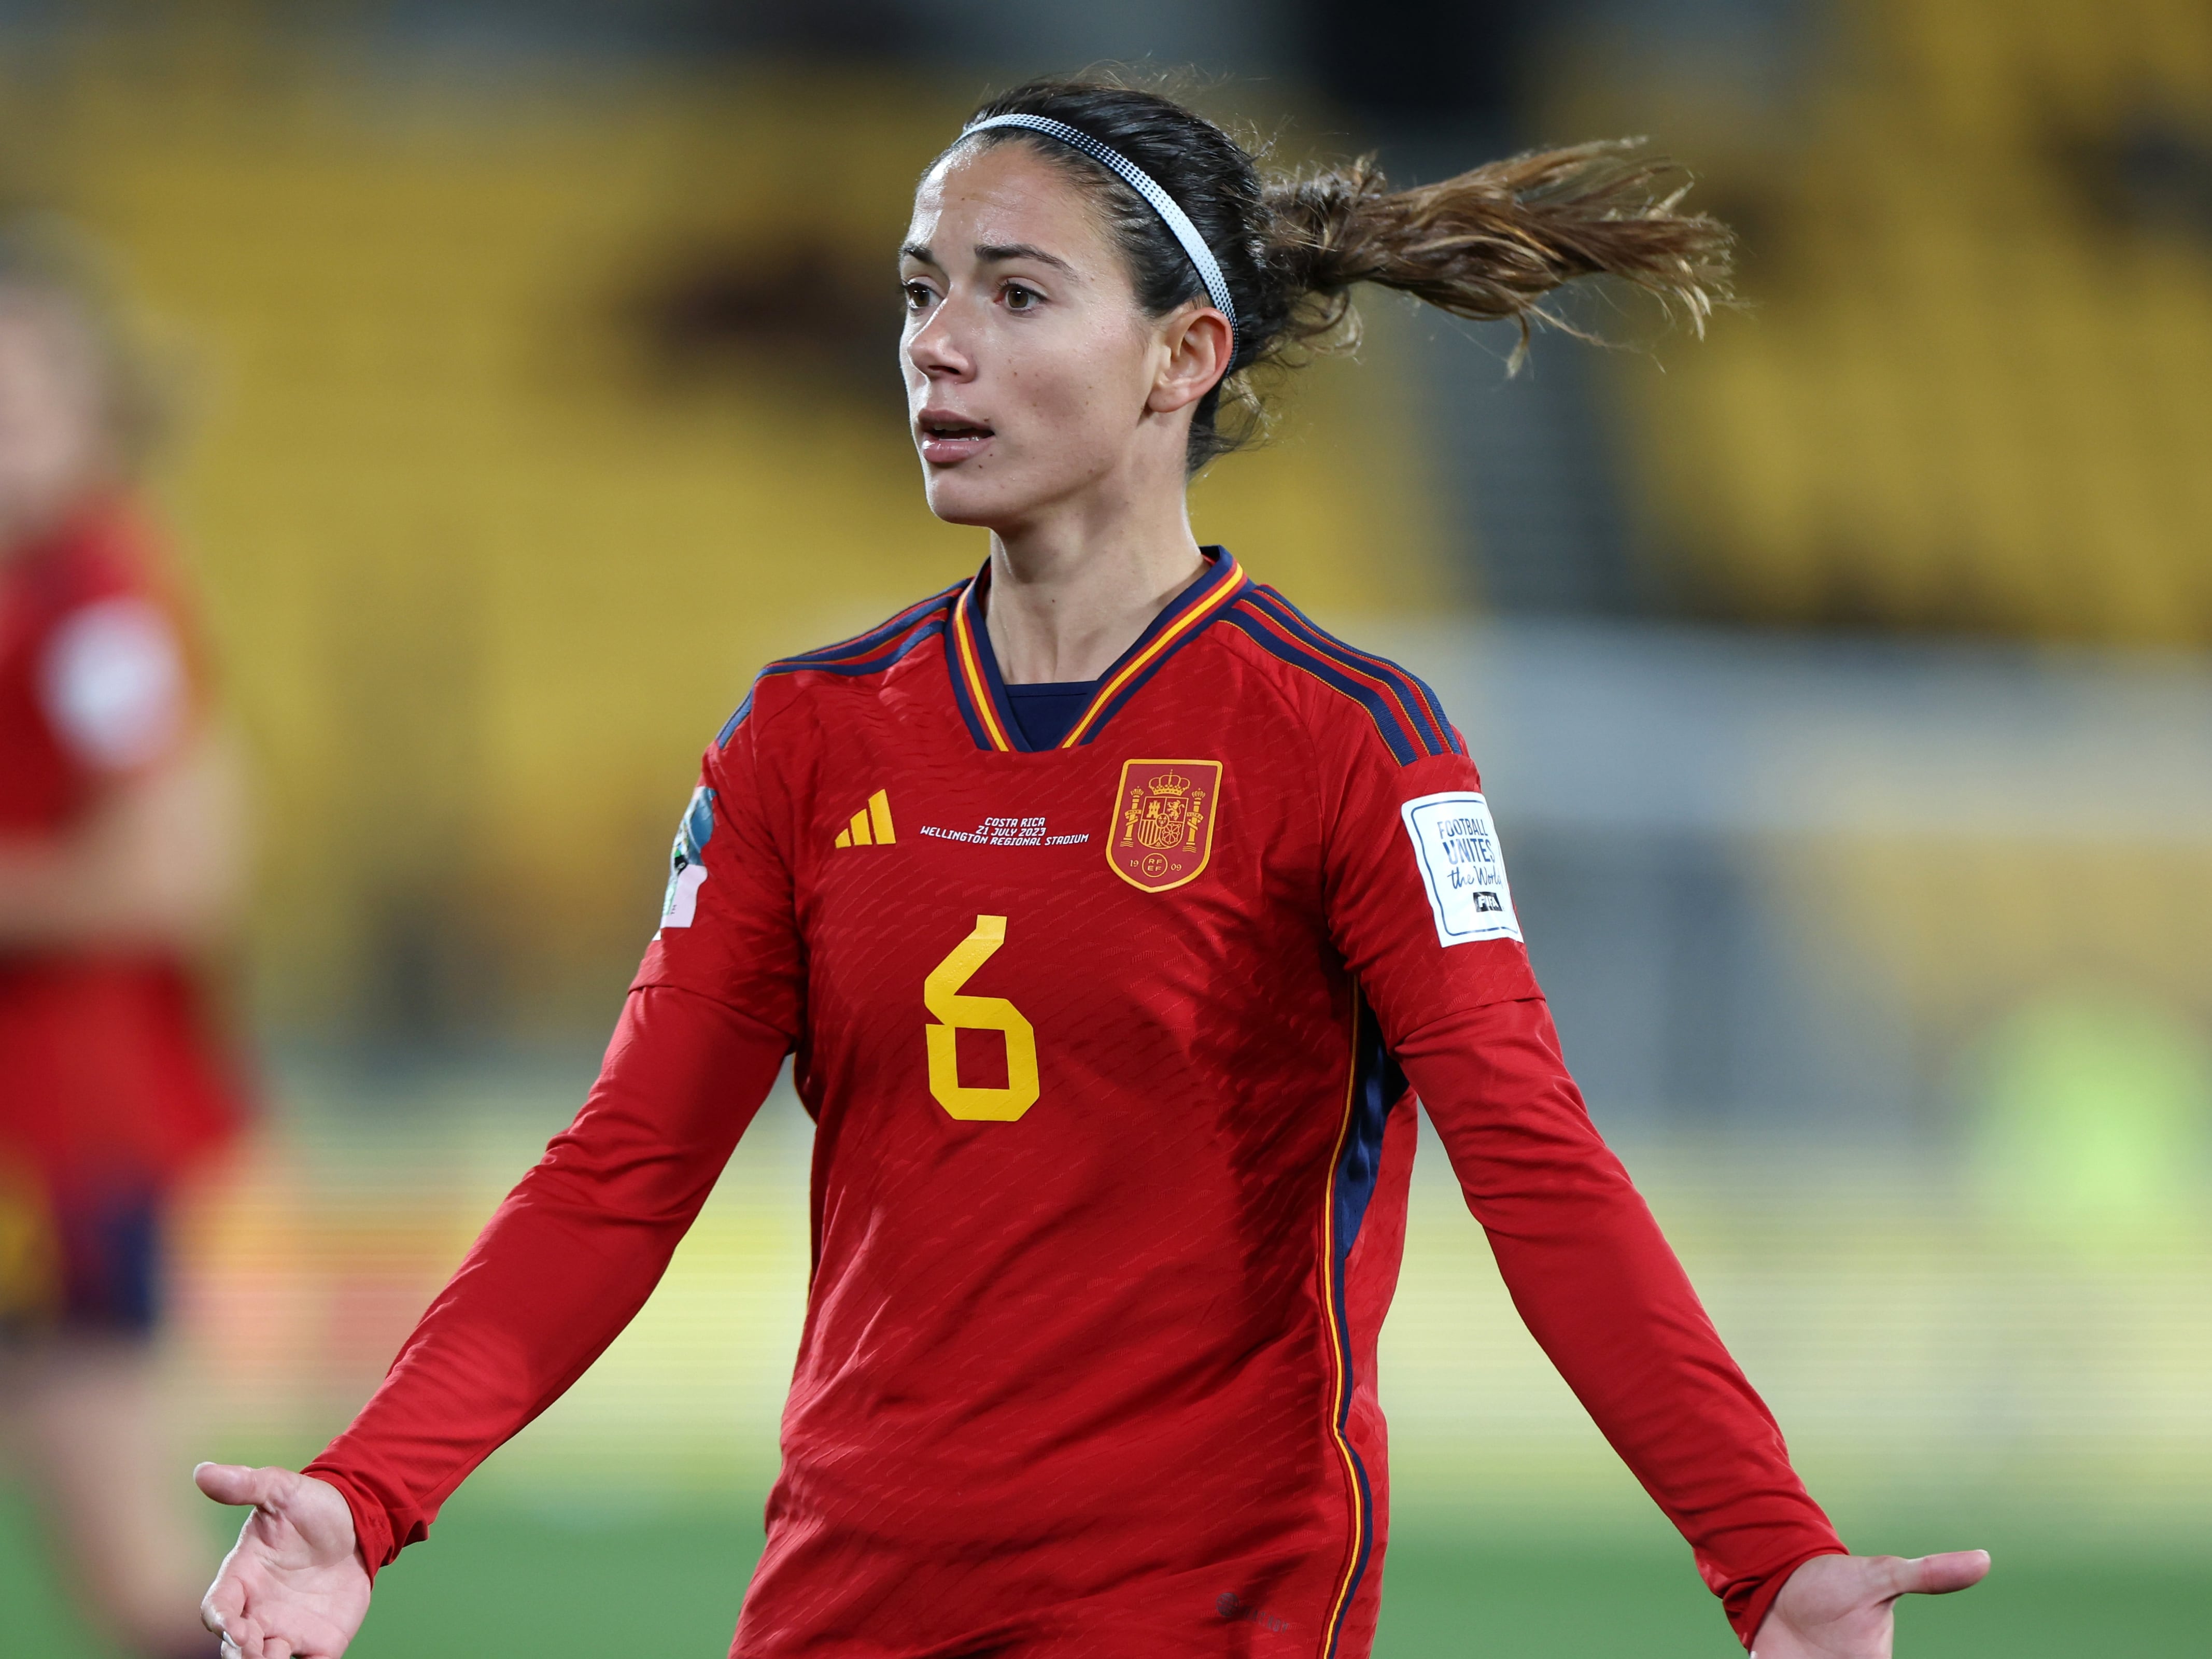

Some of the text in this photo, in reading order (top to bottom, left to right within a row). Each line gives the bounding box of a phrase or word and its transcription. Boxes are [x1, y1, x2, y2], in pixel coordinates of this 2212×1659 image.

[975, 826, 1046, 836] 21 JULY 2023
[984, 817, 1046, 826] COSTA RICA
[1437, 819, 1488, 839] FOOTBALL
[920, 826, 1089, 846] WELLINGTON REGIONAL STADIUM
[1442, 839, 1495, 865] UNITES
[1447, 865, 1503, 889] the World
[1478, 896, 1500, 908] FIFA
[924, 914, 1040, 1122] 6
